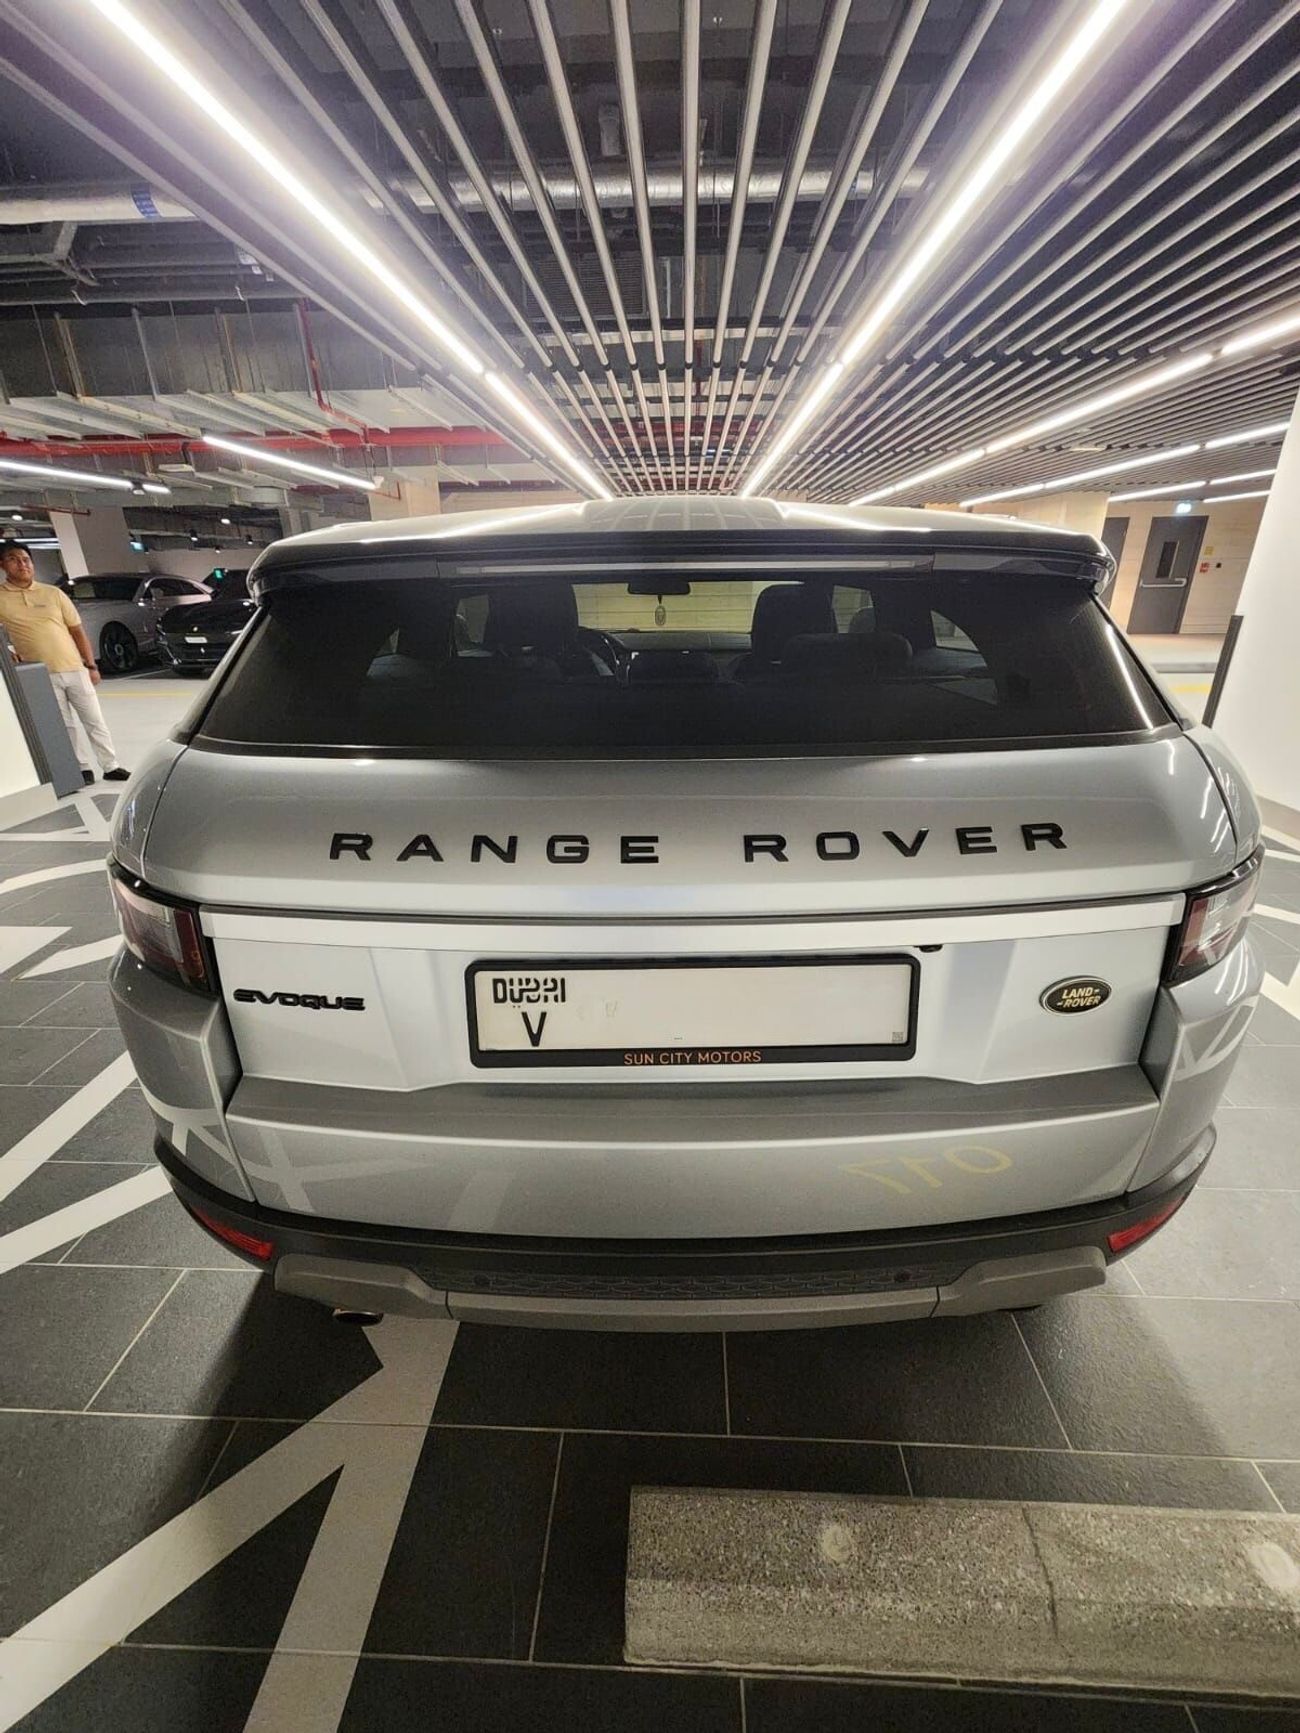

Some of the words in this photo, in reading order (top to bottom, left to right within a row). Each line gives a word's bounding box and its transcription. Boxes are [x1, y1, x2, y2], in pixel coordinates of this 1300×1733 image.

[329, 832, 660, 865] RANGE
[743, 822, 1068, 863] ROVER
[233, 988, 366, 1011] EVOQUE
[521, 1011, 547, 1048] V
[624, 1053, 654, 1065] SUN
[659, 1052, 693, 1064] CITY
[697, 1050, 762, 1063] MOTORS
